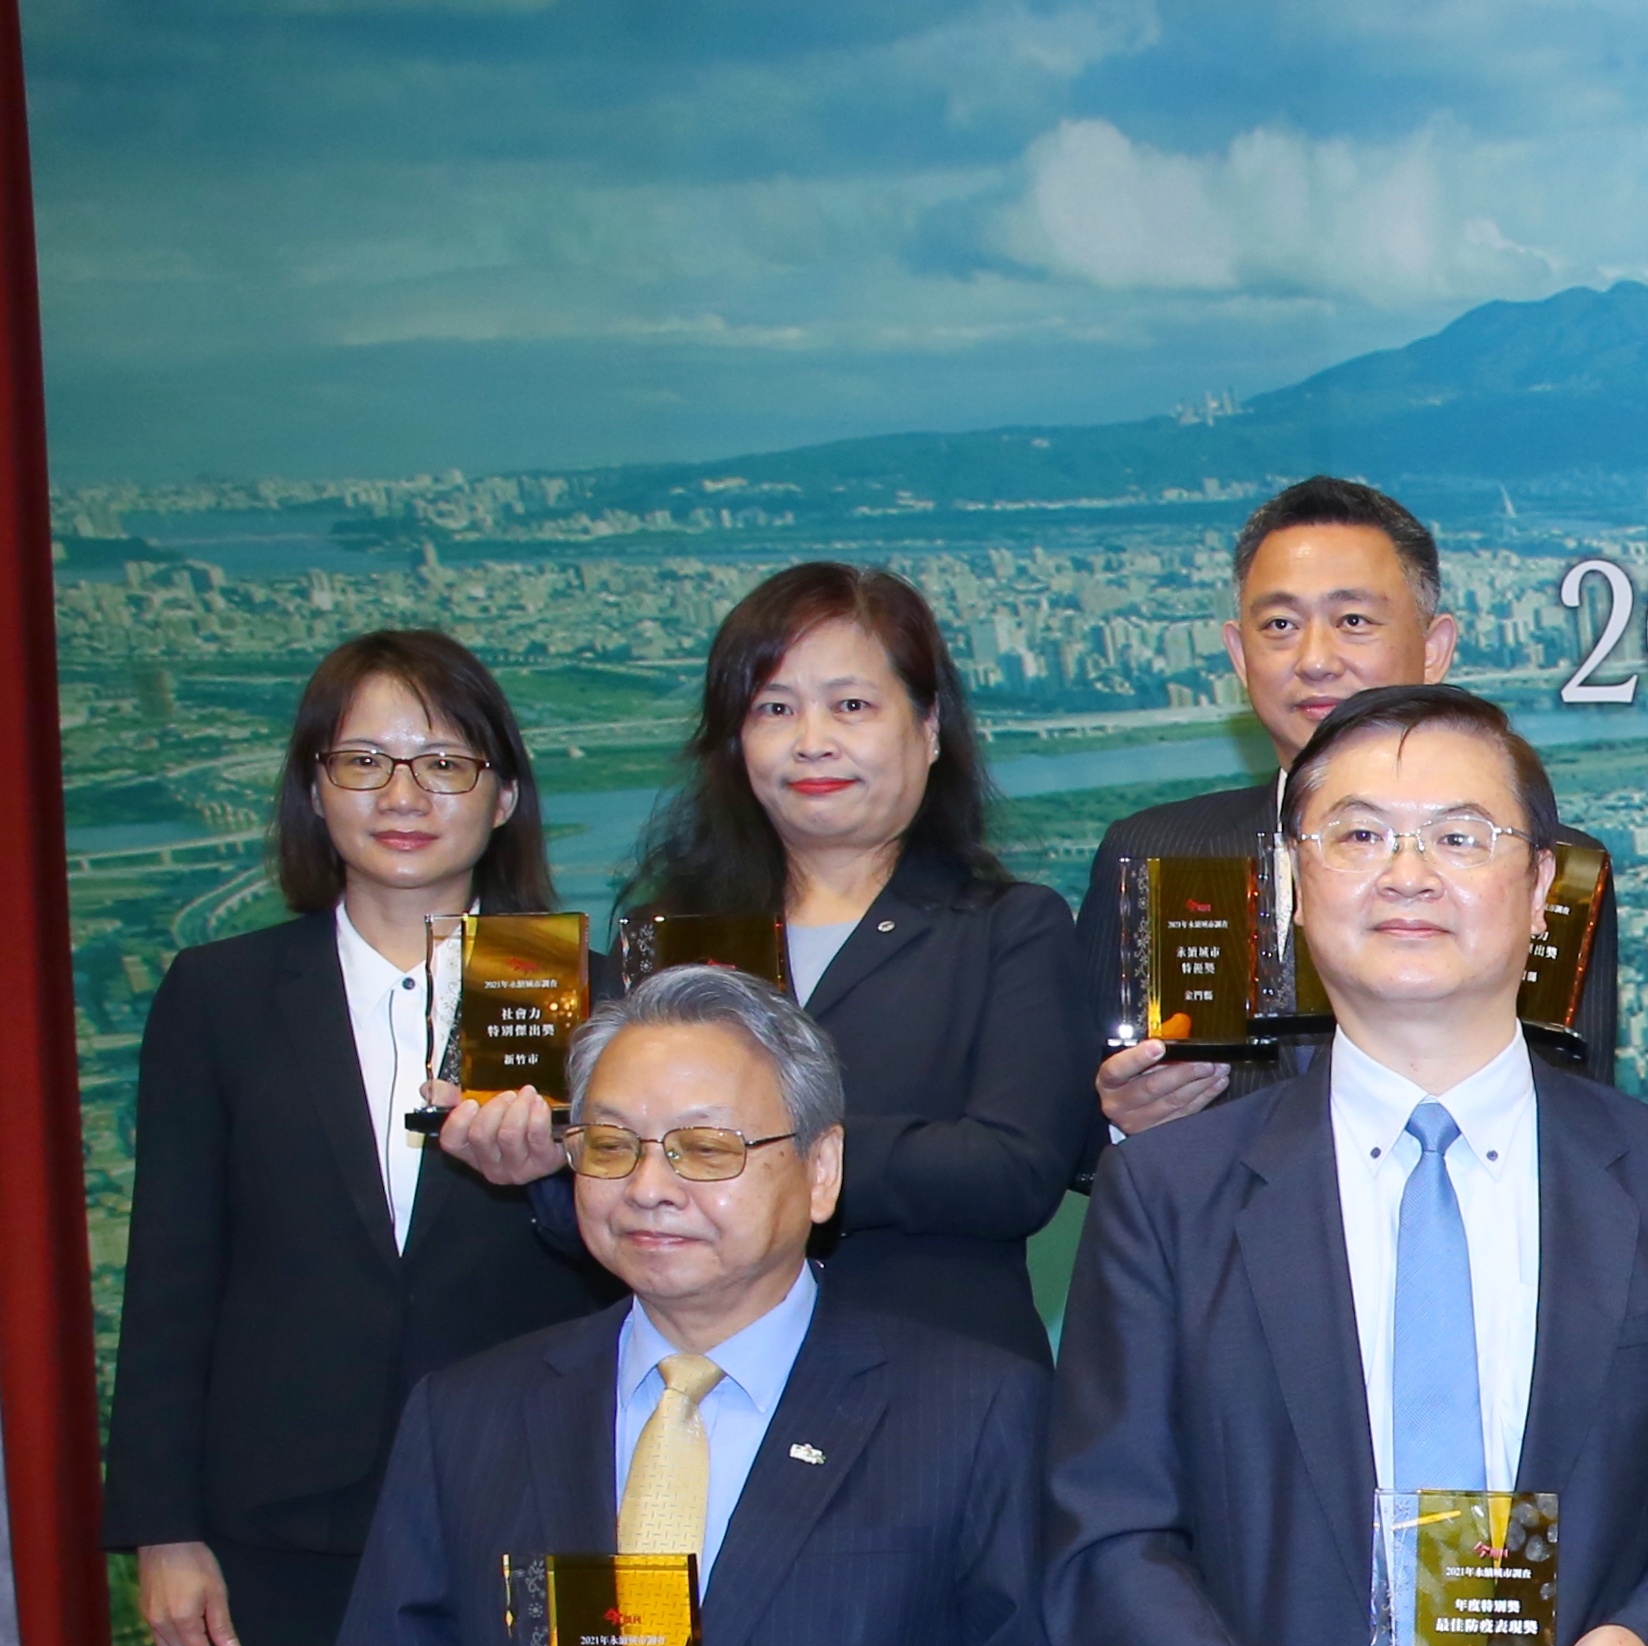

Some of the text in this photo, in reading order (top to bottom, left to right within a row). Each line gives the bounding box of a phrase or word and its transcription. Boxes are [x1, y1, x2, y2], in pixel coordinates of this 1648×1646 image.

[502, 1007, 541, 1020] 社會力
[487, 1025, 555, 1037] 特別傑出獎
[504, 1054, 538, 1065] 新竹市
[1455, 1599, 1520, 1613] 年度特別獎
[1436, 1618, 1538, 1635] 最佳防疫表現獎
